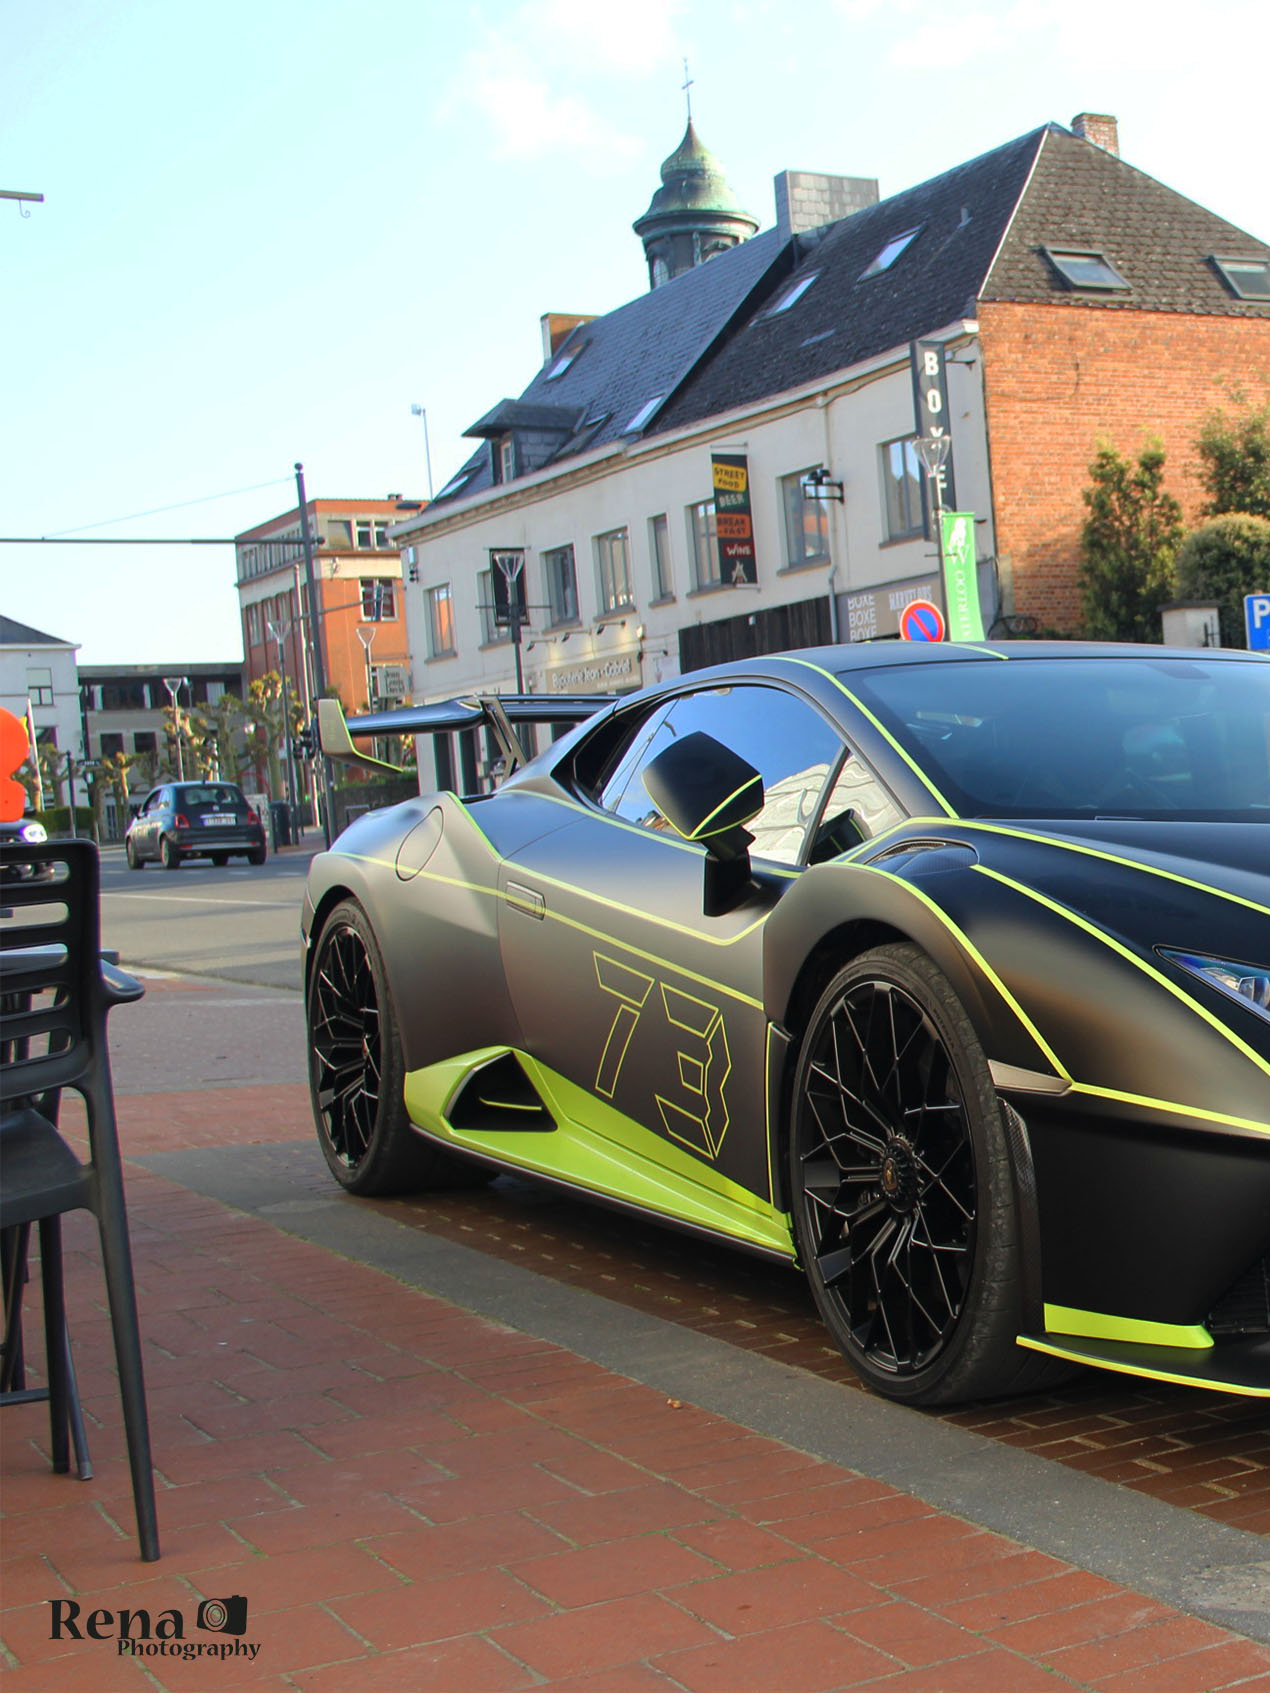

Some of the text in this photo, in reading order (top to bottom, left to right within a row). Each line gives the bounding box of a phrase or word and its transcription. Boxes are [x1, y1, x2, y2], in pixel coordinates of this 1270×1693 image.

[714, 466, 745, 481] STREET
[717, 478, 741, 489] FOOD
[718, 493, 745, 508] BEER
[848, 608, 877, 628] BOXE
[593, 950, 732, 1160] 73
